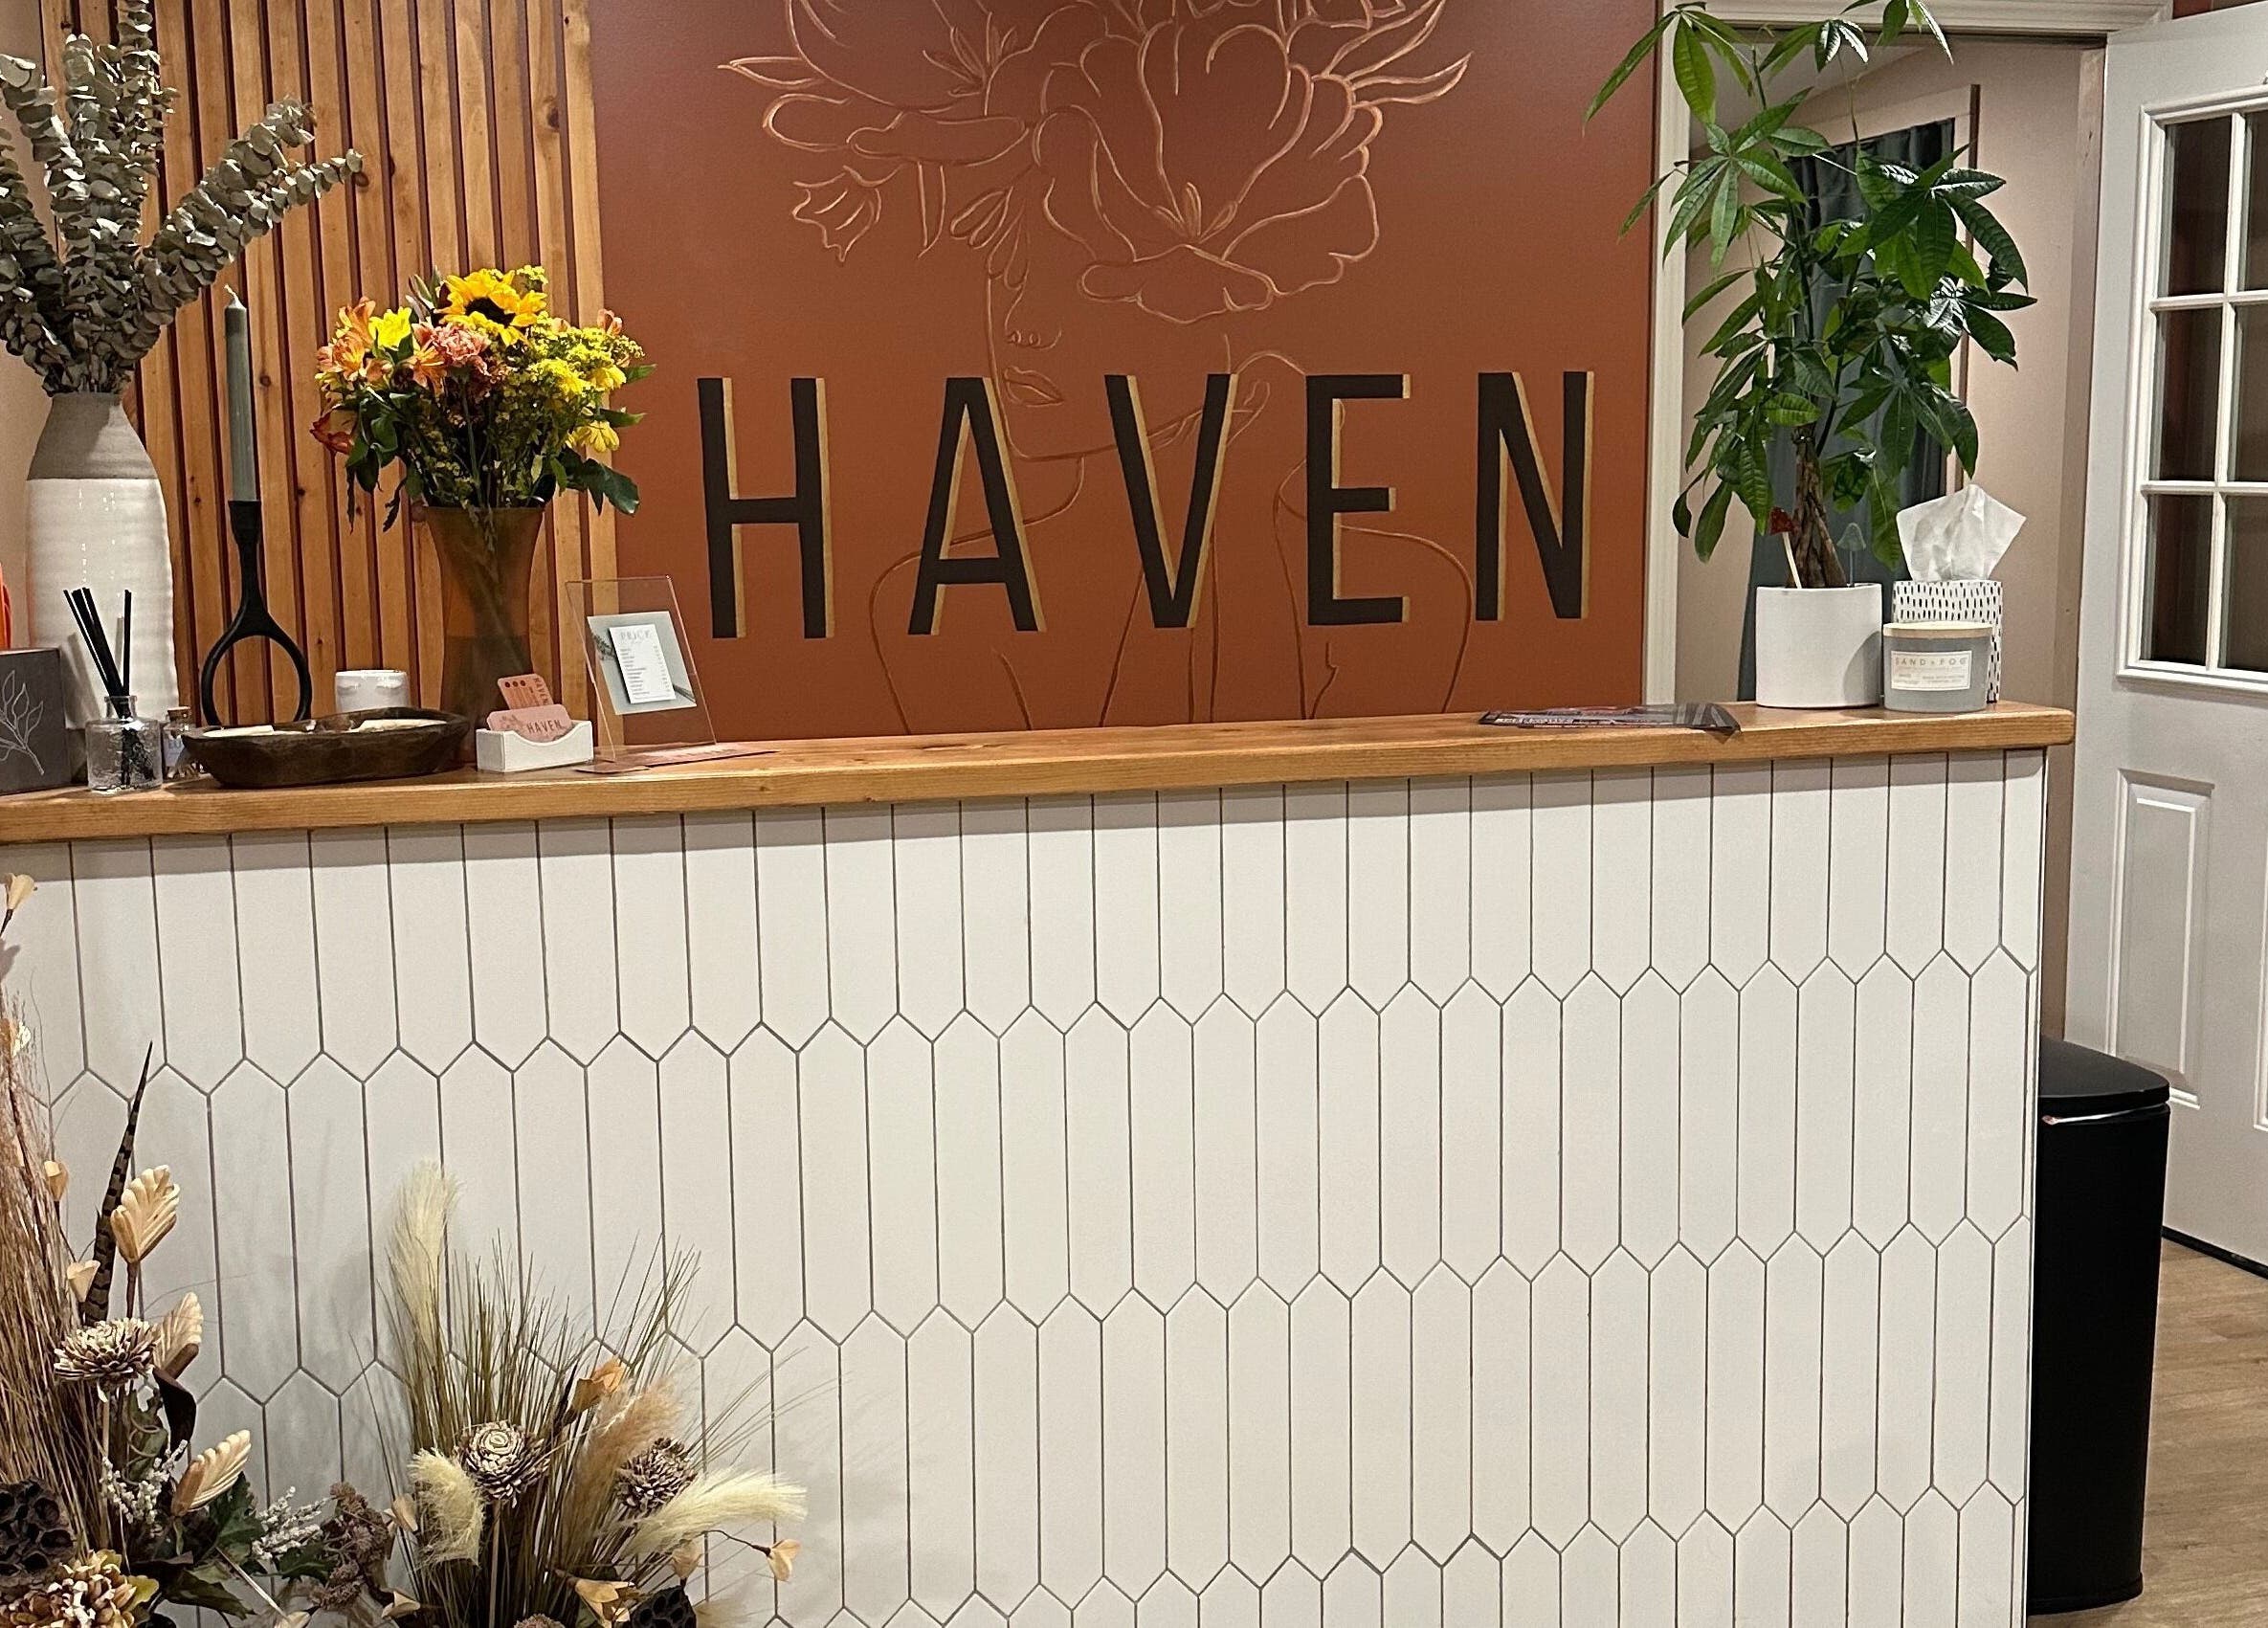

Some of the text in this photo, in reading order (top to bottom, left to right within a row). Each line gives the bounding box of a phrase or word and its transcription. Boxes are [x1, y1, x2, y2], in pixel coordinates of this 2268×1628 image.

[698, 370, 1595, 638] HAVEN
[1895, 658, 1926, 666] SAND
[526, 719, 562, 734] HAVEN
